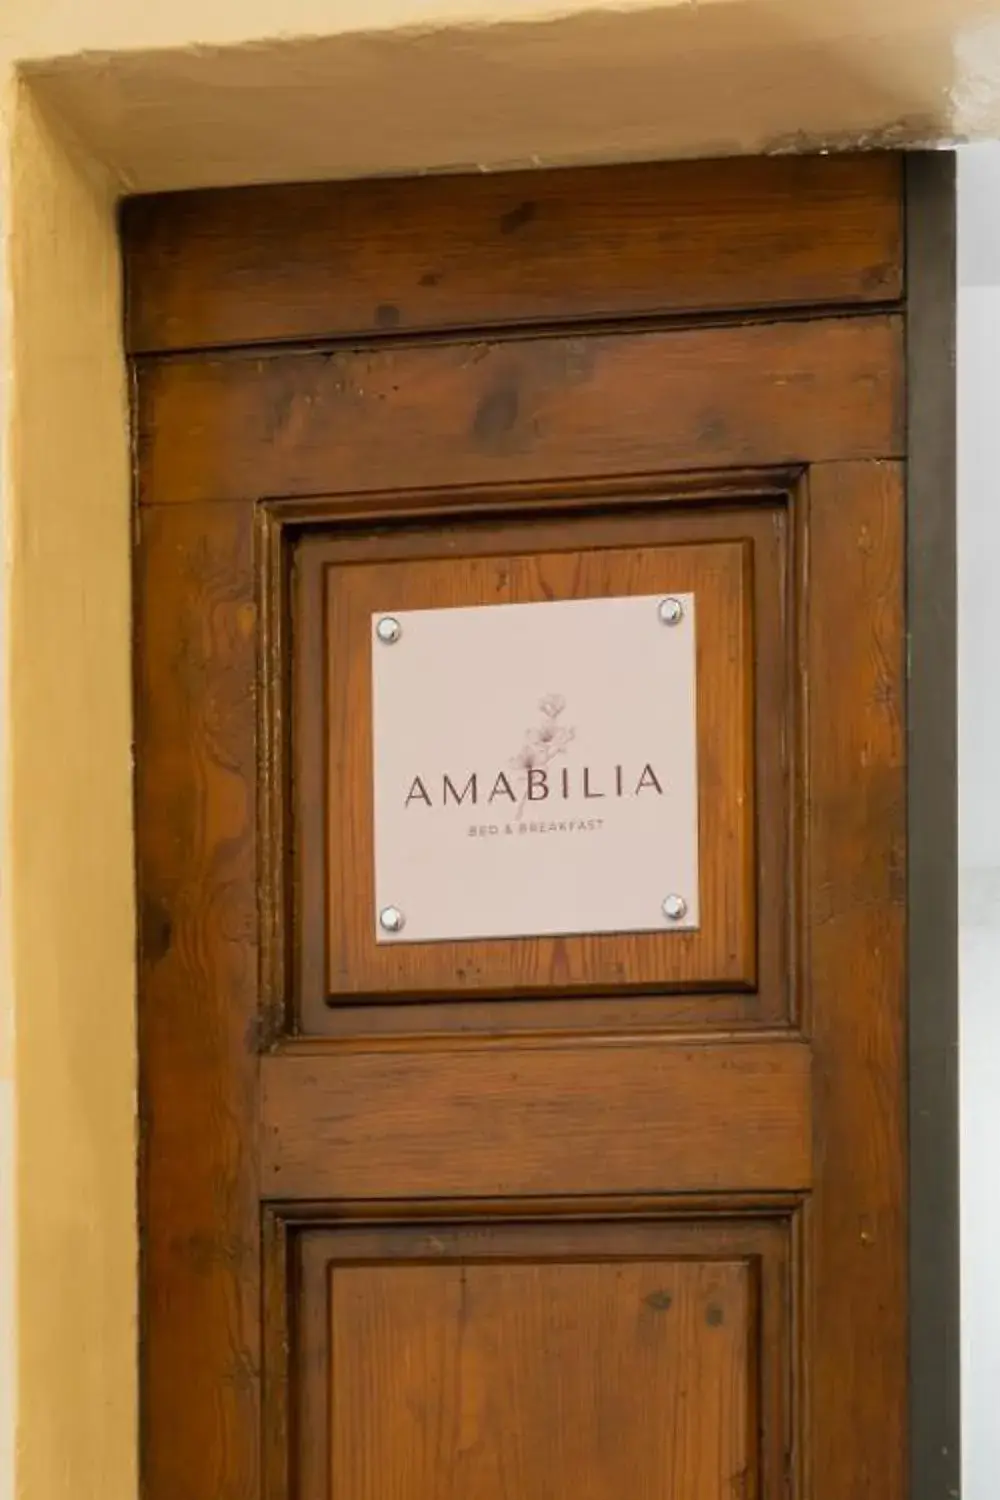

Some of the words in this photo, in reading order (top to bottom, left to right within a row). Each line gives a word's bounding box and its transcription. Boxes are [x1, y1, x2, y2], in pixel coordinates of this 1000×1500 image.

[404, 762, 665, 809] AMABILIA
[467, 825, 499, 838] BED
[504, 823, 514, 836] &
[519, 819, 605, 835] BREAKFAST
